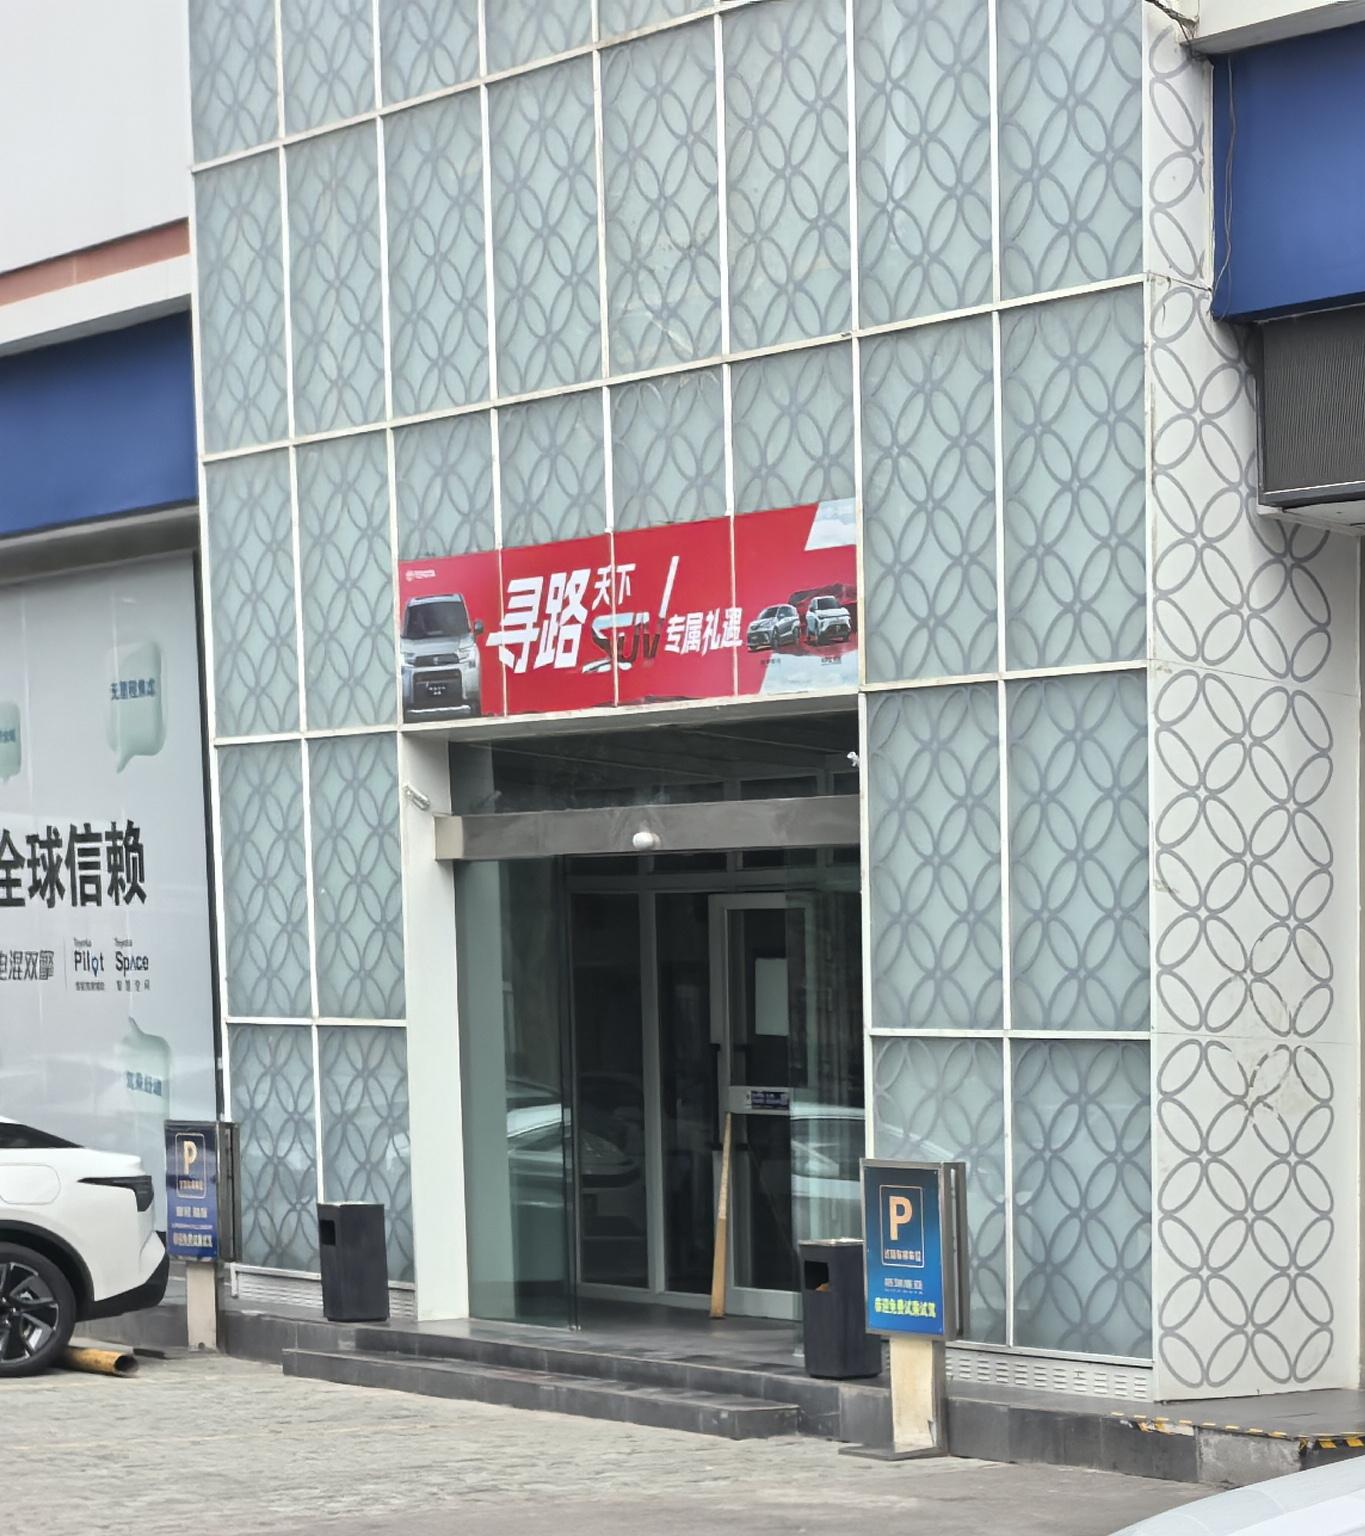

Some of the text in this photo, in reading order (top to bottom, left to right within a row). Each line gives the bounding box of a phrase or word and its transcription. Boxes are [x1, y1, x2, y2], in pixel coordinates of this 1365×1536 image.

[485, 568, 592, 673] 寻路
[665, 606, 744, 656] 专属礼遇
[0, 818, 147, 909] 全球信赖
[74, 950, 104, 977] Pilot
[183, 1140, 197, 1175] P
[889, 1196, 912, 1240] P
